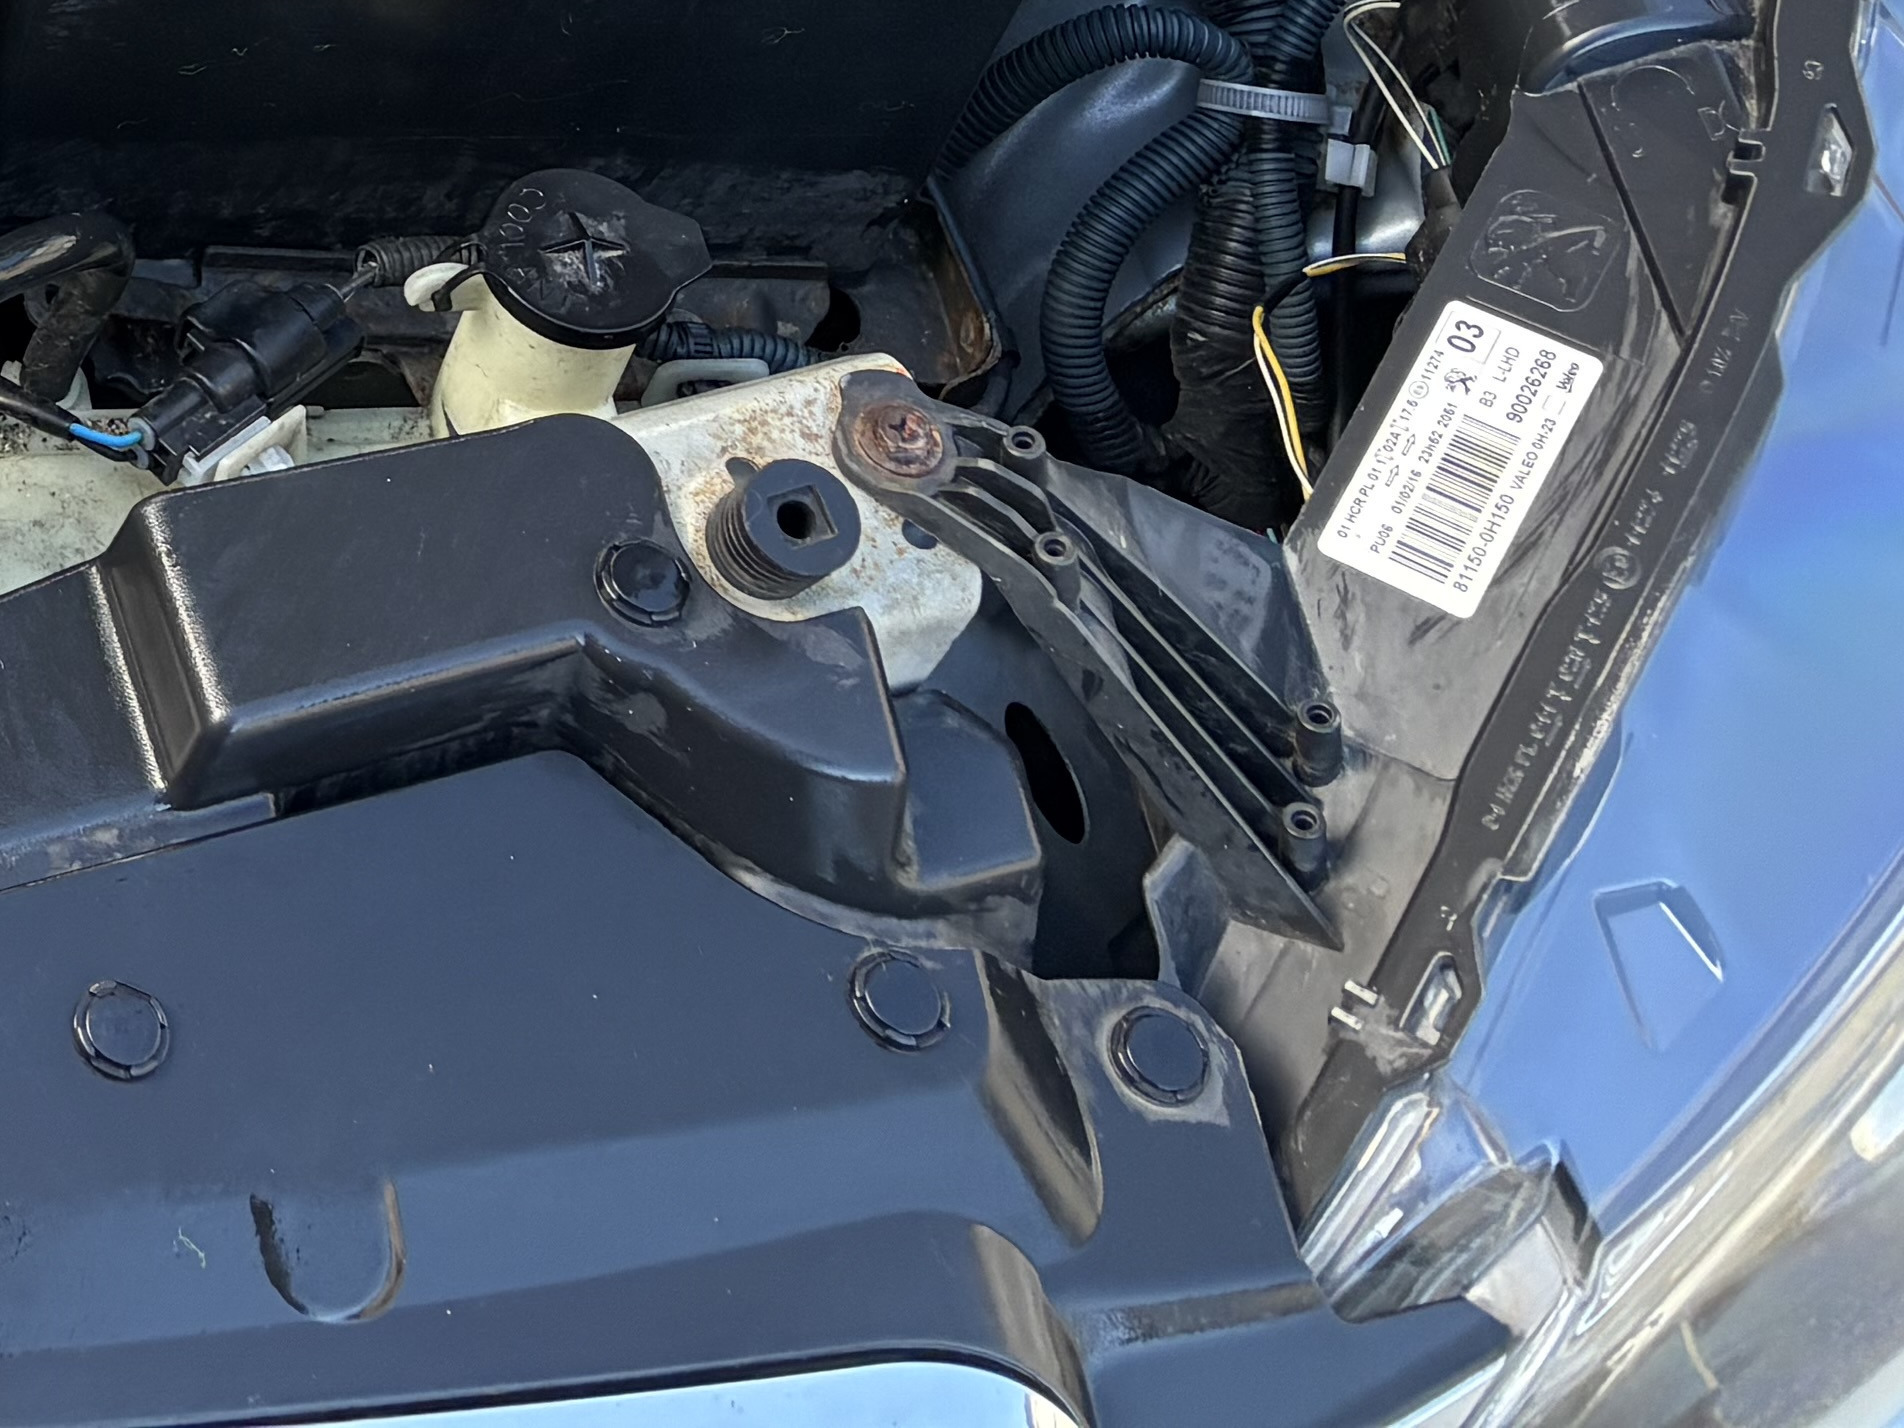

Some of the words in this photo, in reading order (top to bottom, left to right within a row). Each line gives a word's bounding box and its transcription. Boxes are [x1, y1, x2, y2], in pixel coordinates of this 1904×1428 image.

[1446, 320, 1485, 353] 03
[1478, 390, 1497, 408] B3
[1492, 346, 1520, 383] L-LHD
[1505, 349, 1557, 424] 90026268
[1336, 524, 1351, 539] 01
[1344, 497, 1367, 524] HCR
[1358, 484, 1375, 498] PL
[1420, 349, 1445, 381] 11274
[1452, 494, 1515, 593] 81150-0H150
[1509, 451, 1539, 490] VALEO
